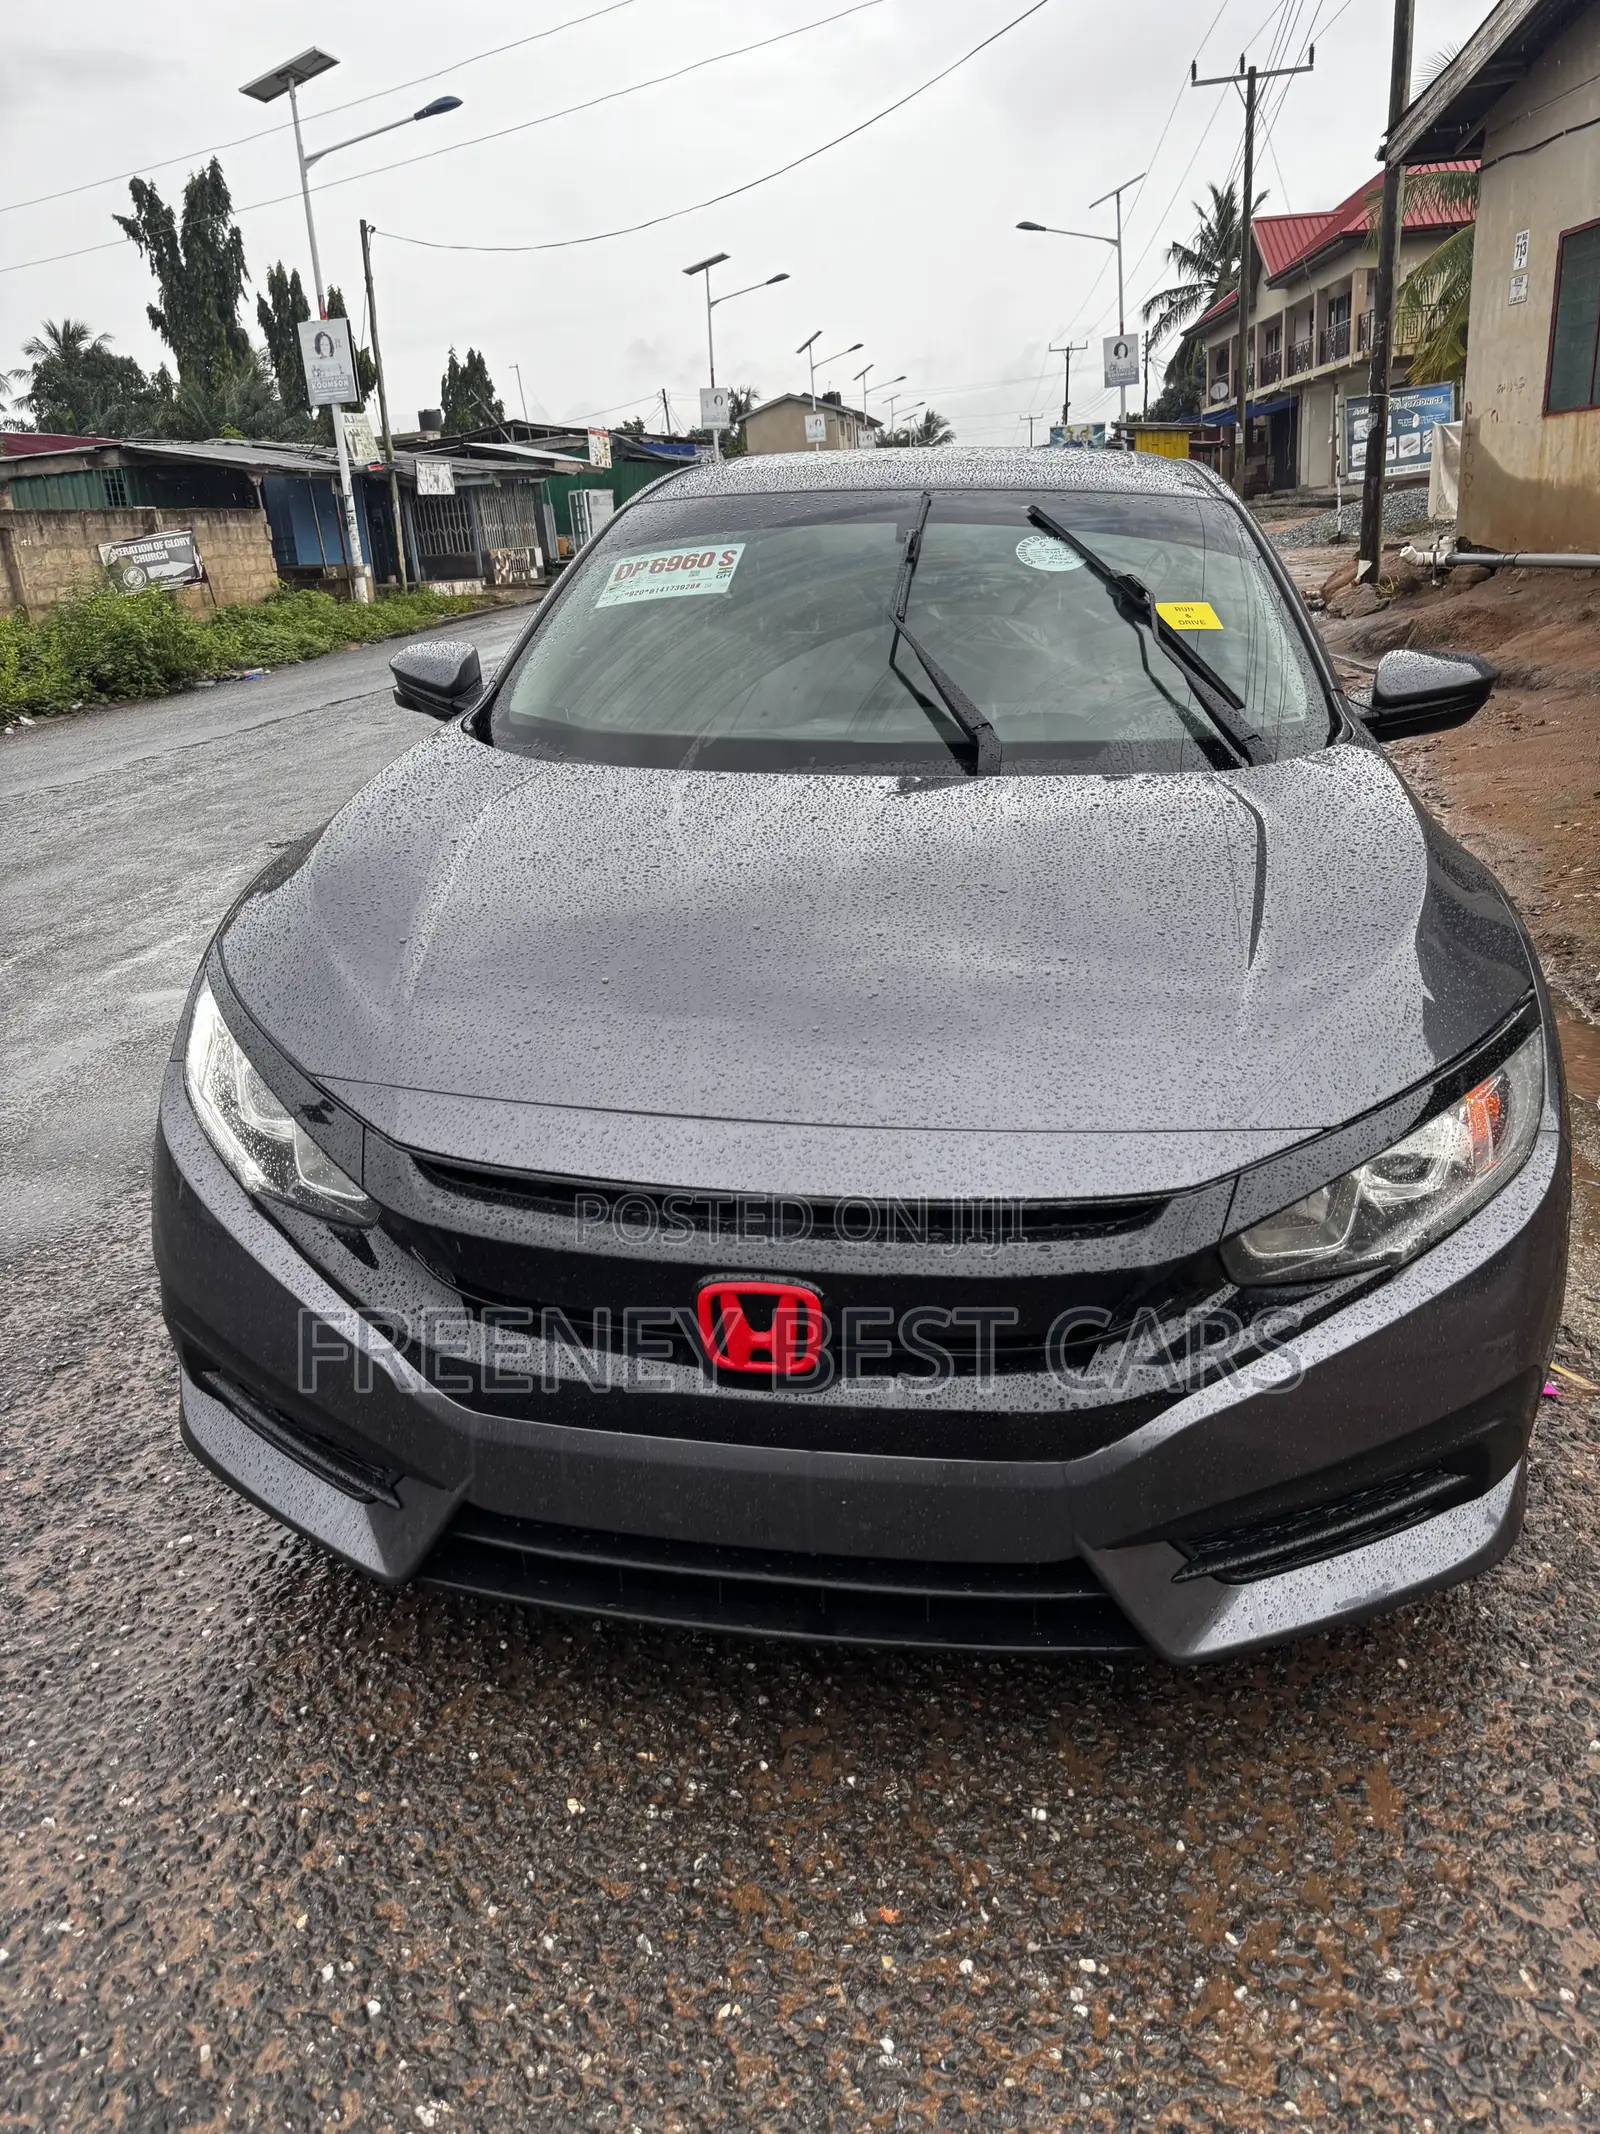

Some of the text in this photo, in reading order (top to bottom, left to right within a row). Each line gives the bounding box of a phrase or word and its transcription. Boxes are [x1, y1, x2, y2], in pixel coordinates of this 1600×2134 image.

[1515, 241, 1527, 259] 713
[153, 540, 164, 551] OF
[165, 537, 191, 549] GLORY
[133, 551, 169, 564] CHURCH
[614, 550, 737, 582] DP 6960 S
